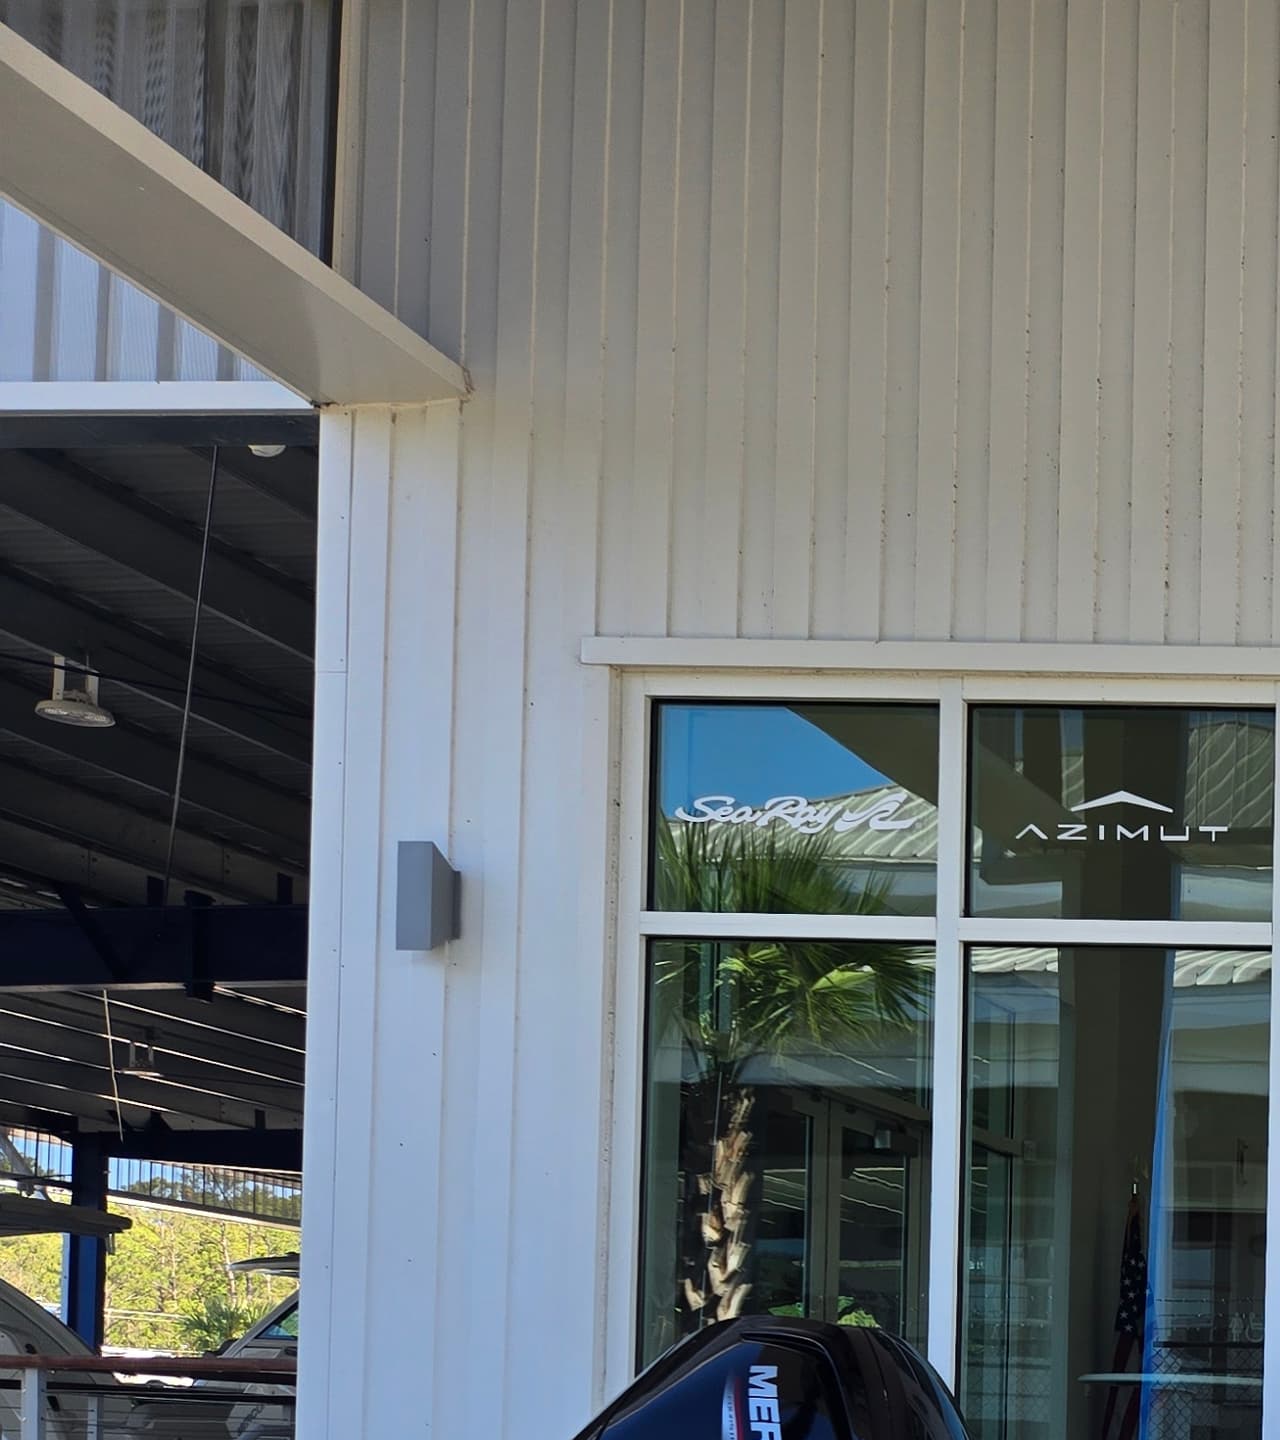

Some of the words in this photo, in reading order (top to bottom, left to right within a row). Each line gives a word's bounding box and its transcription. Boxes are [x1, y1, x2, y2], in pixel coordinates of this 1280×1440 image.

[675, 796, 760, 825] Sea
[757, 795, 842, 834] Ray
[1015, 823, 1229, 842] AZIMUT
